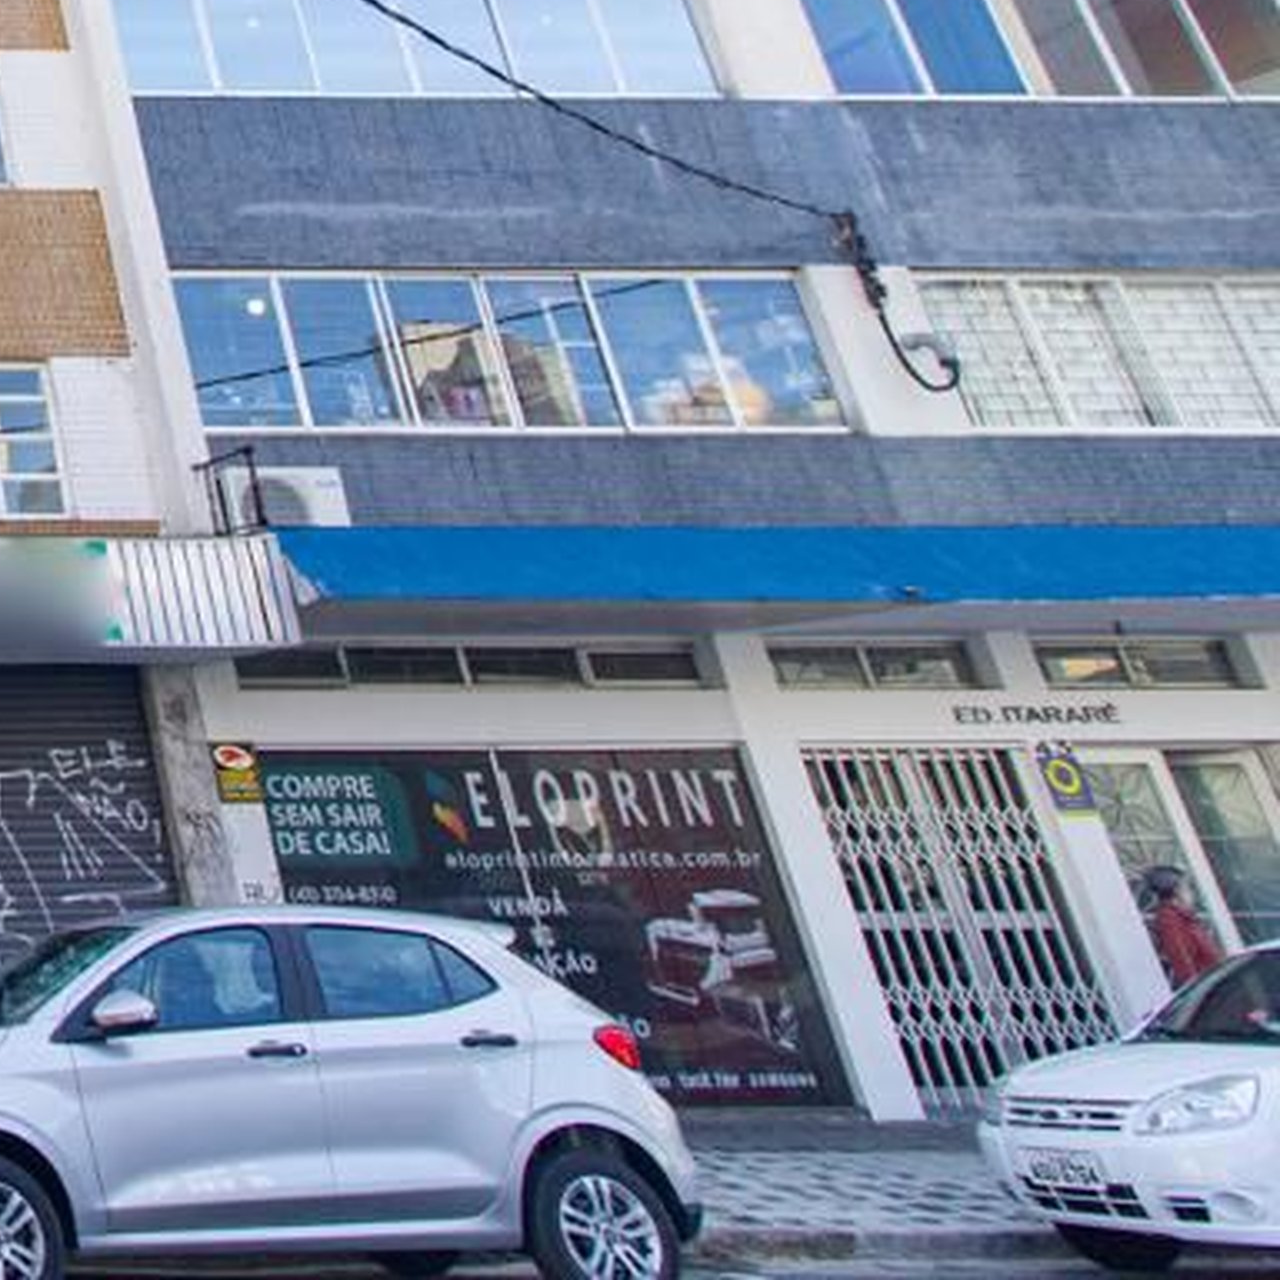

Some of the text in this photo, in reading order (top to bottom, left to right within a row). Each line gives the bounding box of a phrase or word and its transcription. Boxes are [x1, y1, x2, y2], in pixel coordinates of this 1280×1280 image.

[265, 776, 377, 799] COMPRE
[465, 768, 746, 828] ELOPRINT
[271, 804, 385, 828] SEM SAIR
[276, 833, 392, 855] DE CASA!
